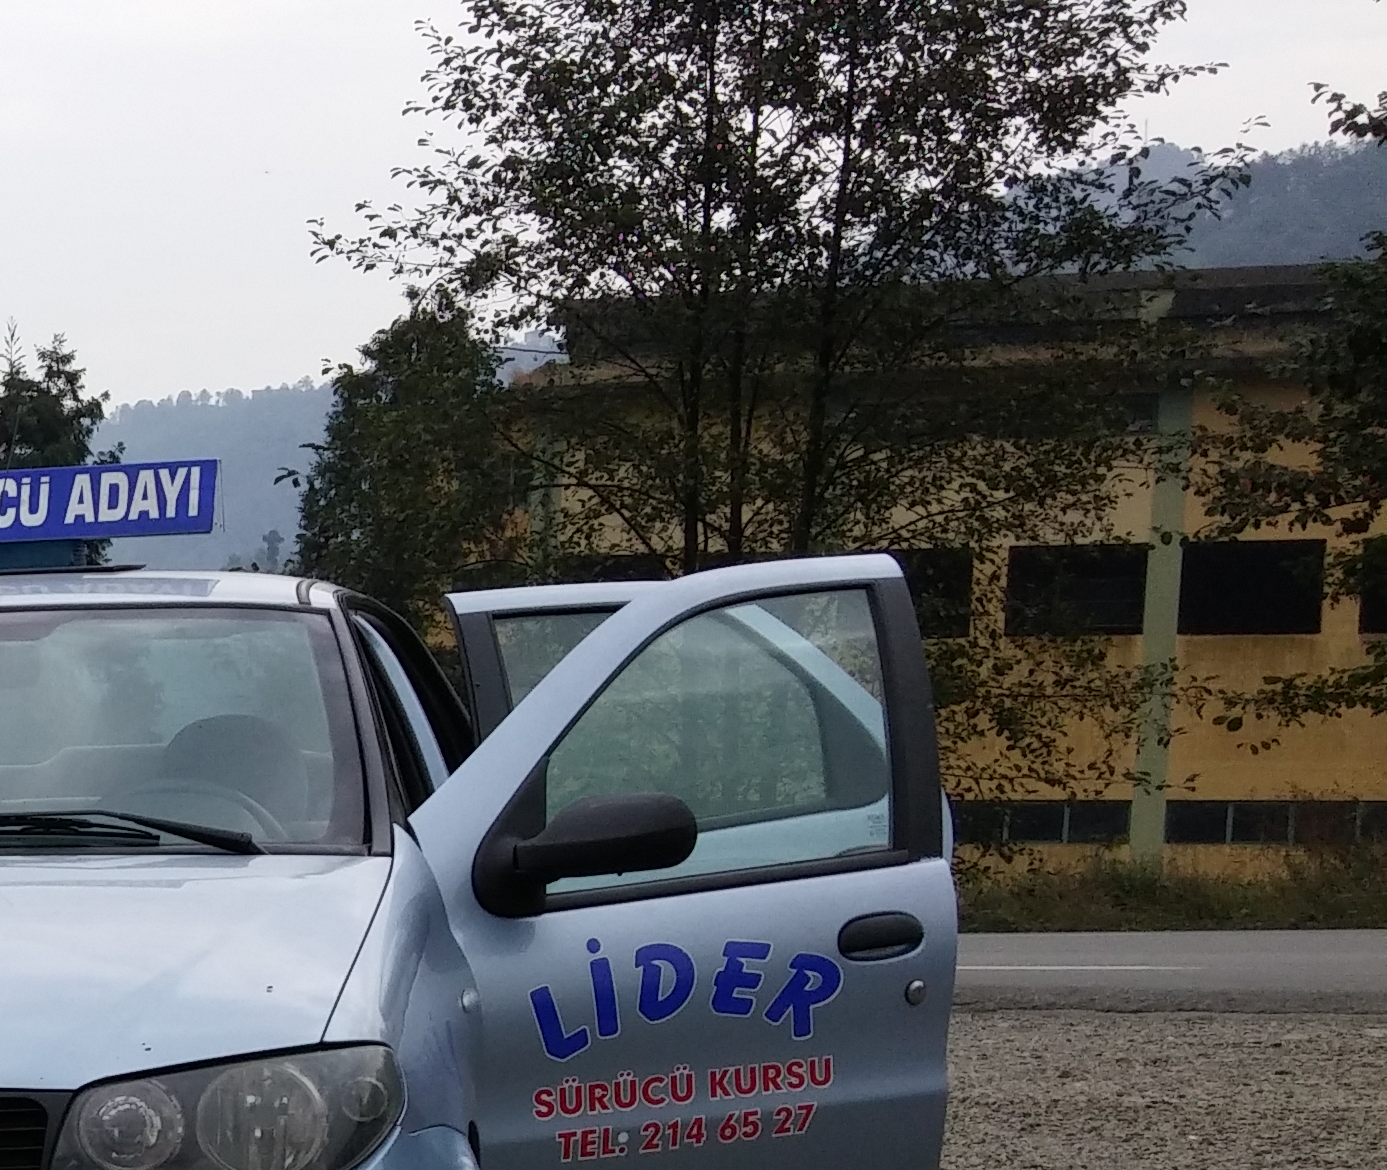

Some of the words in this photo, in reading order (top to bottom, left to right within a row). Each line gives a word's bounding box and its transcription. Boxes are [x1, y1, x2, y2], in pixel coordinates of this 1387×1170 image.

[63, 465, 202, 525] ADAYI
[529, 937, 845, 1062] LİDER
[532, 1064, 695, 1120] SÜRÜCÜ
[708, 1055, 834, 1102] KURSU
[638, 1116, 706, 1155] 214
[717, 1108, 762, 1145] 65
[773, 1102, 818, 1138] 27
